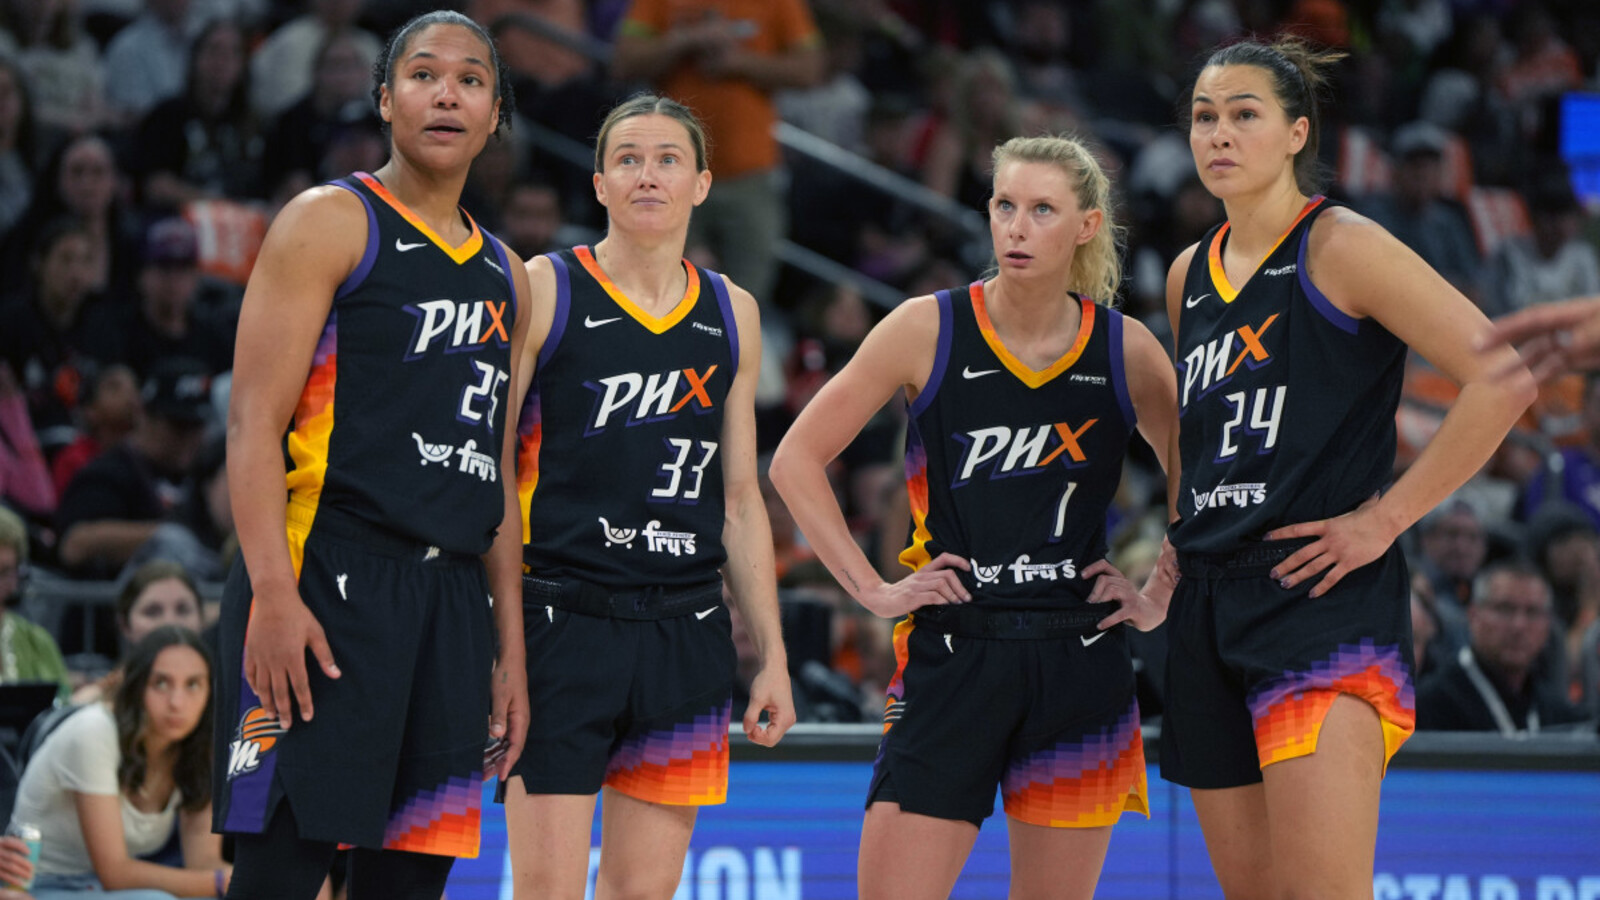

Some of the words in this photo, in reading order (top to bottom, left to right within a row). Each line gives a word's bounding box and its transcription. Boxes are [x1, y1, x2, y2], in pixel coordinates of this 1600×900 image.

[411, 299, 510, 355] PHX
[1180, 312, 1281, 409] PHX
[459, 359, 510, 429] 25
[592, 364, 720, 430] PHX
[1218, 384, 1288, 459] 24
[650, 437, 719, 499] 33
[957, 417, 1100, 482] PHX
[641, 518, 697, 557] fry's
[1053, 481, 1078, 538] 1
